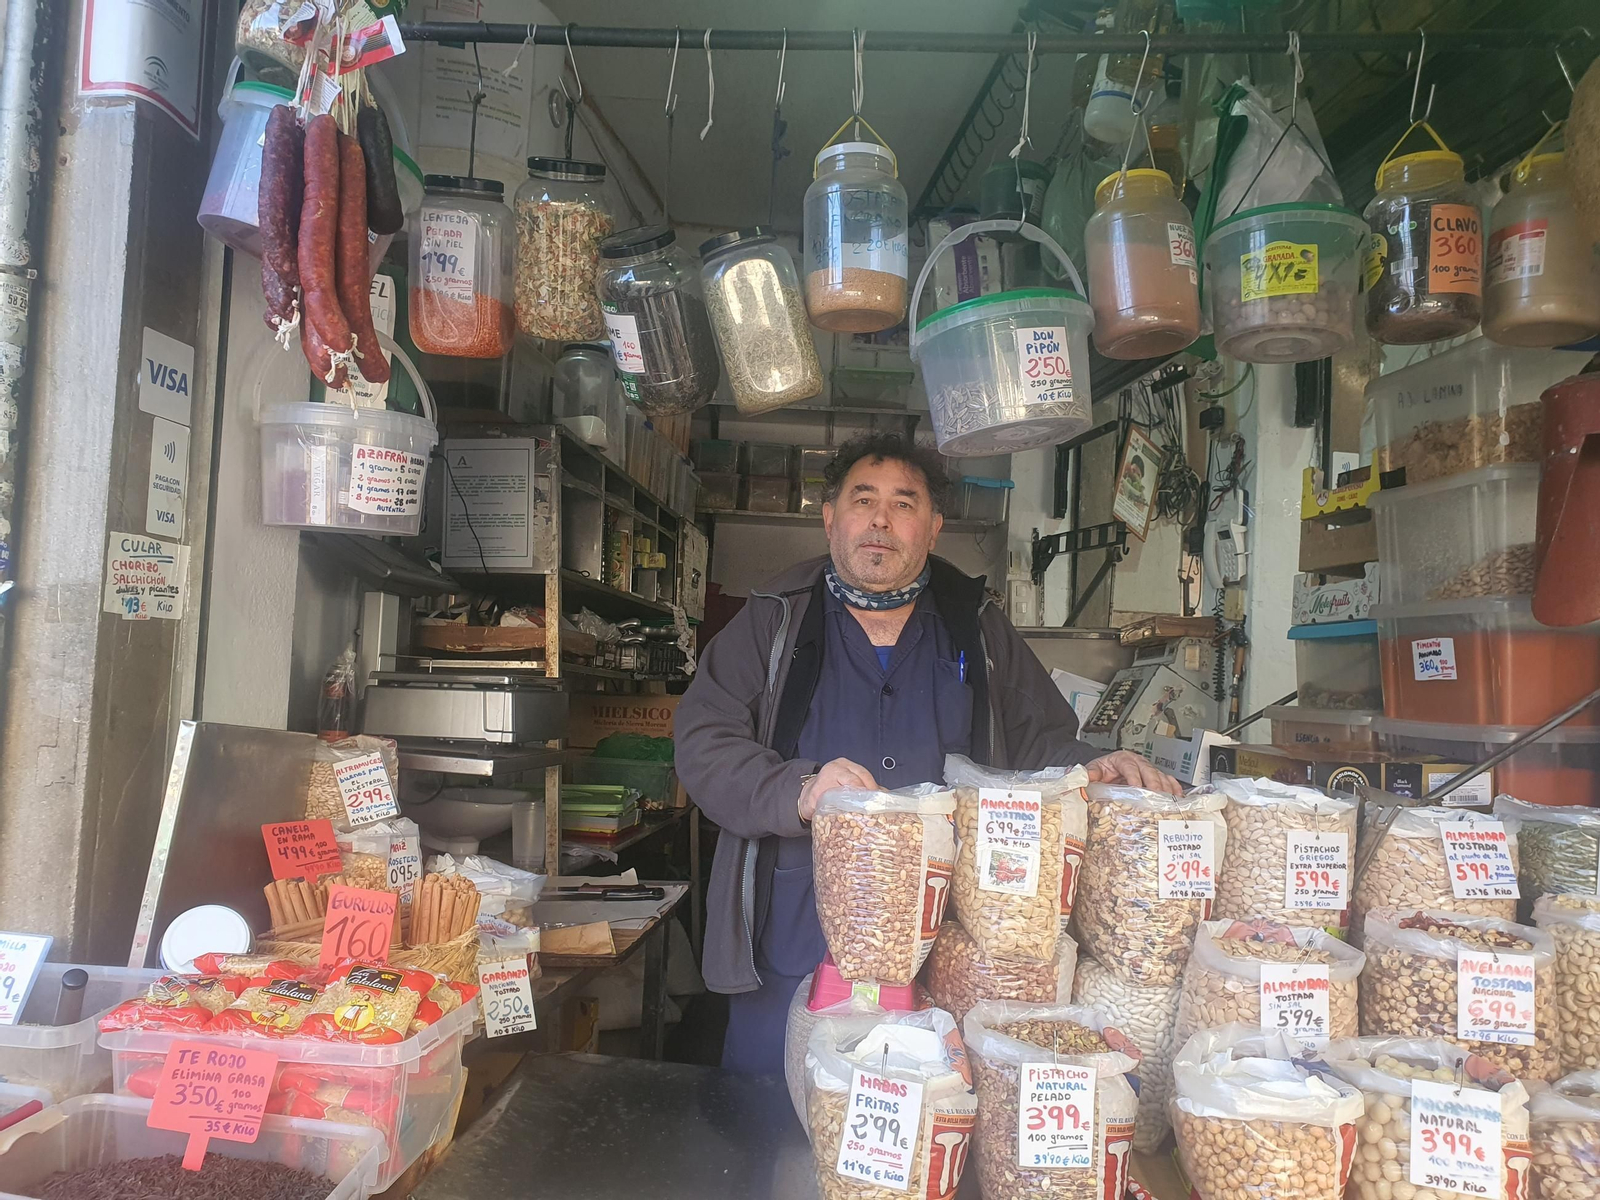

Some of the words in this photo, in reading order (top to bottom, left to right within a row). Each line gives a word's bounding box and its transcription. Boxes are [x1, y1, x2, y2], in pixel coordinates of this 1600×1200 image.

[423, 212, 469, 225] LENTEJA
[426, 226, 463, 239] PELADA
[1433, 217, 1478, 235] CLAVO
[424, 238, 441, 248] SIN
[445, 238, 464, 249] PIEL
[1263, 252, 1296, 263] GRANADA
[1432, 264, 1451, 273] 100
[424, 275, 443, 284] 250
[444, 276, 473, 286] gramos
[1032, 330, 1054, 341] DON
[1025, 340, 1060, 355] PIPÓN
[145, 357, 189, 397] VISA
[1030, 380, 1047, 388] 250
[1048, 379, 1073, 388] gramos
[356, 448, 408, 464] AZAFRÁN
[359, 462, 365, 470] 1
[368, 464, 393, 474] gramo
[400, 464, 406, 474] 5
[154, 473, 169, 483] PAGA
[169, 477, 181, 487] CON
[357, 474, 364, 482] 2
[366, 476, 391, 485] gramos
[396, 476, 403, 485] 9
[152, 482, 182, 495] SEGURIDAD
[357, 483, 364, 492] 4
[366, 485, 390, 494] gramos
[355, 493, 362, 501] 8
[364, 496, 389, 504] gramos
[155, 508, 176, 525] VISA
[120, 538, 163, 555] CULAR
[111, 558, 159, 573] CHORIZO
[112, 572, 166, 586] SALCHICHÓN
[140, 587, 146, 596] y
[148, 584, 180, 596] picantes
[591, 705, 672, 720] MIELSICO
[335, 757, 383, 777] ALTRAMUCES
[339, 770, 367, 784] buenos
[368, 765, 385, 775] para
[1336, 770, 1359, 780] SOLOMON
[344, 777, 384, 794] COLESTEROL
[351, 807, 365, 815] 250
[365, 800, 394, 814] gramos
[980, 797, 1040, 812] ANACARDO
[987, 810, 1036, 822] TOSTADO
[271, 824, 310, 837] CANELA
[1444, 830, 1507, 843] ALMENDRA
[277, 836, 289, 845] EN
[292, 832, 316, 842] RAMA
[315, 840, 328, 849] 100
[1163, 832, 1204, 844] REBUJITO
[317, 847, 340, 860] gramos
[1167, 844, 1202, 852] TOSTADO
[1293, 843, 1341, 854] PISTACHOS
[1449, 841, 1499, 853] TOSTADA
[387, 855, 419, 868] ROSETERO
[1171, 852, 1185, 862] SIN
[1298, 854, 1335, 862] GRIEGOS
[1448, 853, 1459, 861] al
[1461, 852, 1481, 862] punto
[1494, 852, 1509, 860] SAL
[1289, 862, 1313, 870] EXTRA
[1315, 861, 1348, 871] SUPERIOR
[1172, 880, 1187, 888] 250
[1188, 880, 1211, 889] gramos
[1465, 886, 1489, 896] 23'96
[1294, 888, 1310, 896] 250
[1311, 888, 1339, 898] gramos
[331, 891, 394, 915] GURULLOS
[325, 914, 388, 958] 1'60
[351, 969, 379, 977] La
[1459, 958, 1533, 979] AVELLANA
[481, 968, 528, 985] GARBANZO
[346, 975, 395, 992] Catalana
[1262, 977, 1329, 994] ALMENDRA
[1470, 975, 1533, 993] TOSTADA
[263, 985, 313, 1001] Catalana
[493, 986, 521, 997] TOSTADO
[1274, 992, 1315, 1003] TOSTADA
[1471, 986, 1516, 998] NACIONAL
[1267, 1002, 1282, 1011] SIN
[1287, 1001, 1303, 1009] SAL
[498, 1016, 511, 1025] 250
[511, 1013, 532, 1024] gramos
[1470, 1017, 1492, 1026] 250
[1493, 1020, 1528, 1030] gramos
[1293, 1027, 1324, 1036] gramos
[178, 1049, 201, 1065] TE
[206, 1050, 247, 1070] ROJO
[171, 1068, 222, 1083] ELIMINA
[227, 1072, 266, 1088] GRASA
[1028, 1068, 1089, 1083] PISTACHO
[860, 1074, 908, 1098] HABAS
[1035, 1081, 1088, 1091] NATURAL
[231, 1088, 252, 1099] 100
[1030, 1092, 1072, 1102] PELADO
[226, 1100, 263, 1115] gramos
[855, 1093, 900, 1115] FRITAS
[204, 1120, 221, 1132] 35
[1105, 1116, 1118, 1124] CON
[1419, 1112, 1483, 1134] NATURAL
[1027, 1133, 1047, 1143] 100
[1050, 1133, 1084, 1145] gramos
[846, 1139, 866, 1152] 250
[866, 1146, 902, 1161] gramos
[1033, 1151, 1062, 1165] 39'90
[1428, 1155, 1450, 1168] 100
[1456, 1160, 1495, 1174] gramos
[842, 1159, 872, 1176] 11'96
[1424, 1173, 1458, 1189] 39'90
